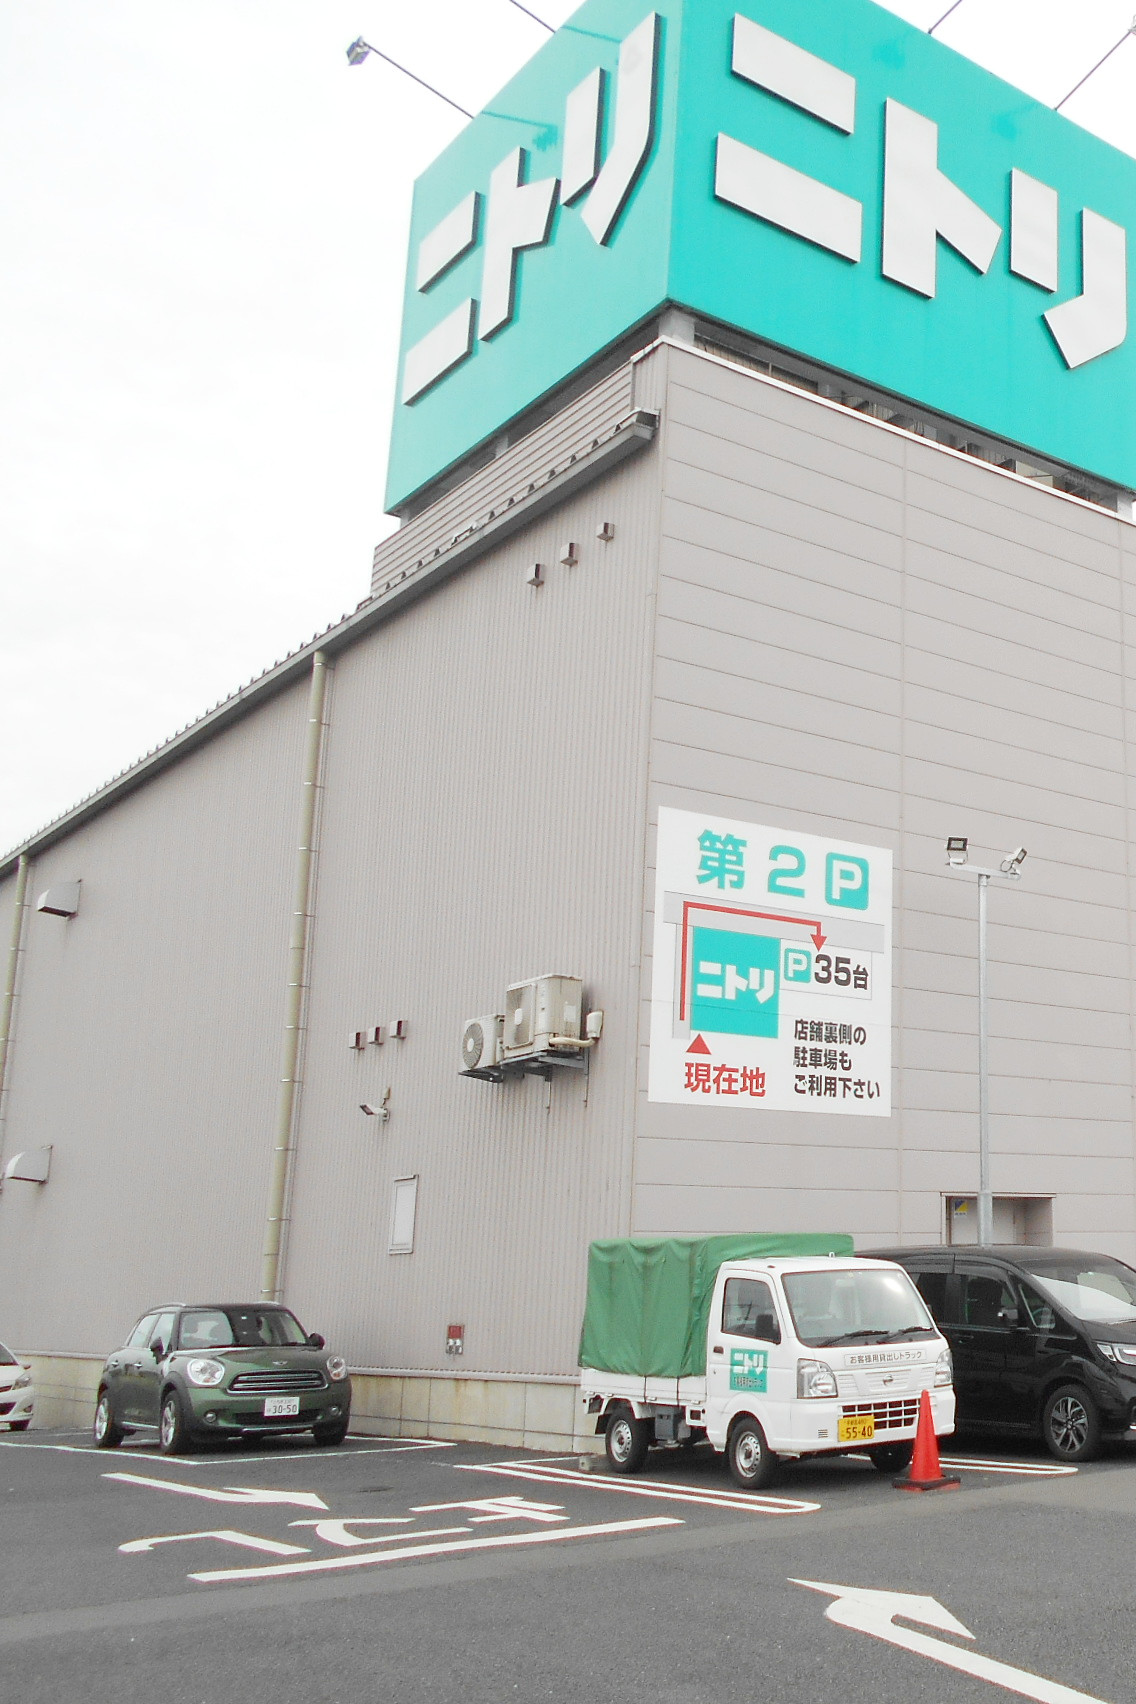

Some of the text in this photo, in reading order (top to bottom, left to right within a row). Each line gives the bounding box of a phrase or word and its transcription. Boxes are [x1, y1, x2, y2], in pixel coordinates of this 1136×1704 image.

[713, 12, 1127, 369] ニトリ
[404, 12, 661, 406] ニトリ
[696, 961, 775, 1004] ニトリ
[794, 1018, 867, 1047] 店舗裏側の
[793, 1046, 853, 1072] 駐車場も
[683, 1062, 767, 1097] 現在地
[793, 1073, 881, 1099] ご利用下さい
[733, 1352, 764, 1375] ニトリ
[272, 1404, 298, 1413] 30-50
[846, 1425, 873, 1439] 55-40
